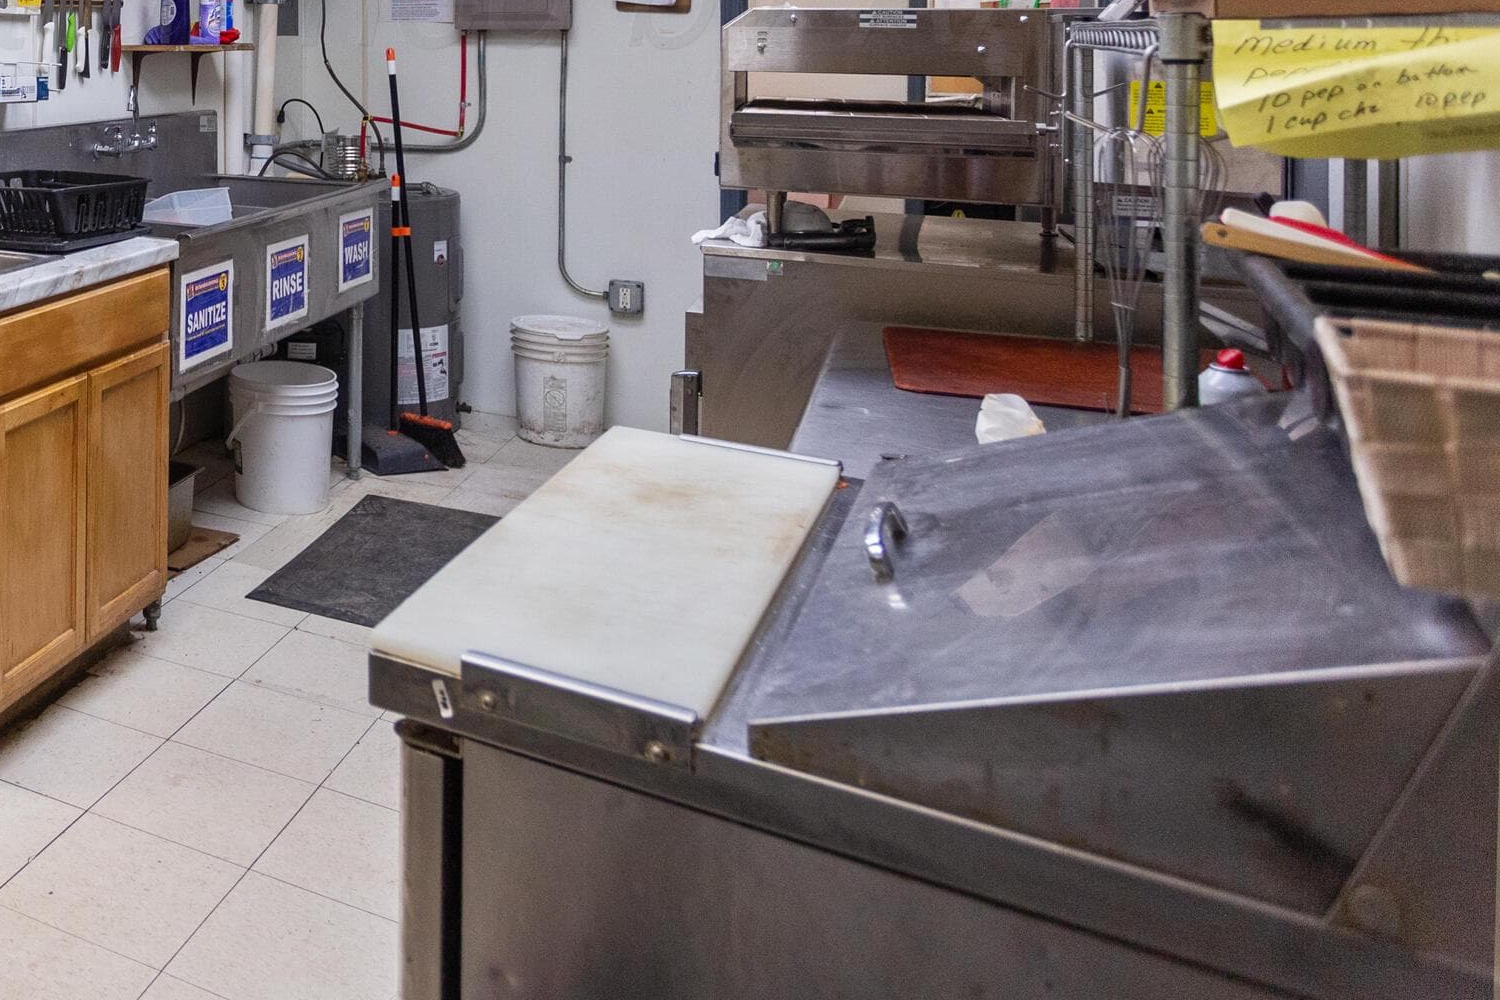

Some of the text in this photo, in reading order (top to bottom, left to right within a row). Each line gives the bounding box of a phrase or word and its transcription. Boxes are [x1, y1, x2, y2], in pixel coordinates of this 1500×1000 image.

[1258, 92, 1291, 113] 10
[1301, 85, 1343, 108] pep
[1284, 112, 1327, 131] cup
[345, 240, 368, 265] WASH
[272, 271, 303, 301] RINSE
[187, 301, 227, 334] SANITIZE
